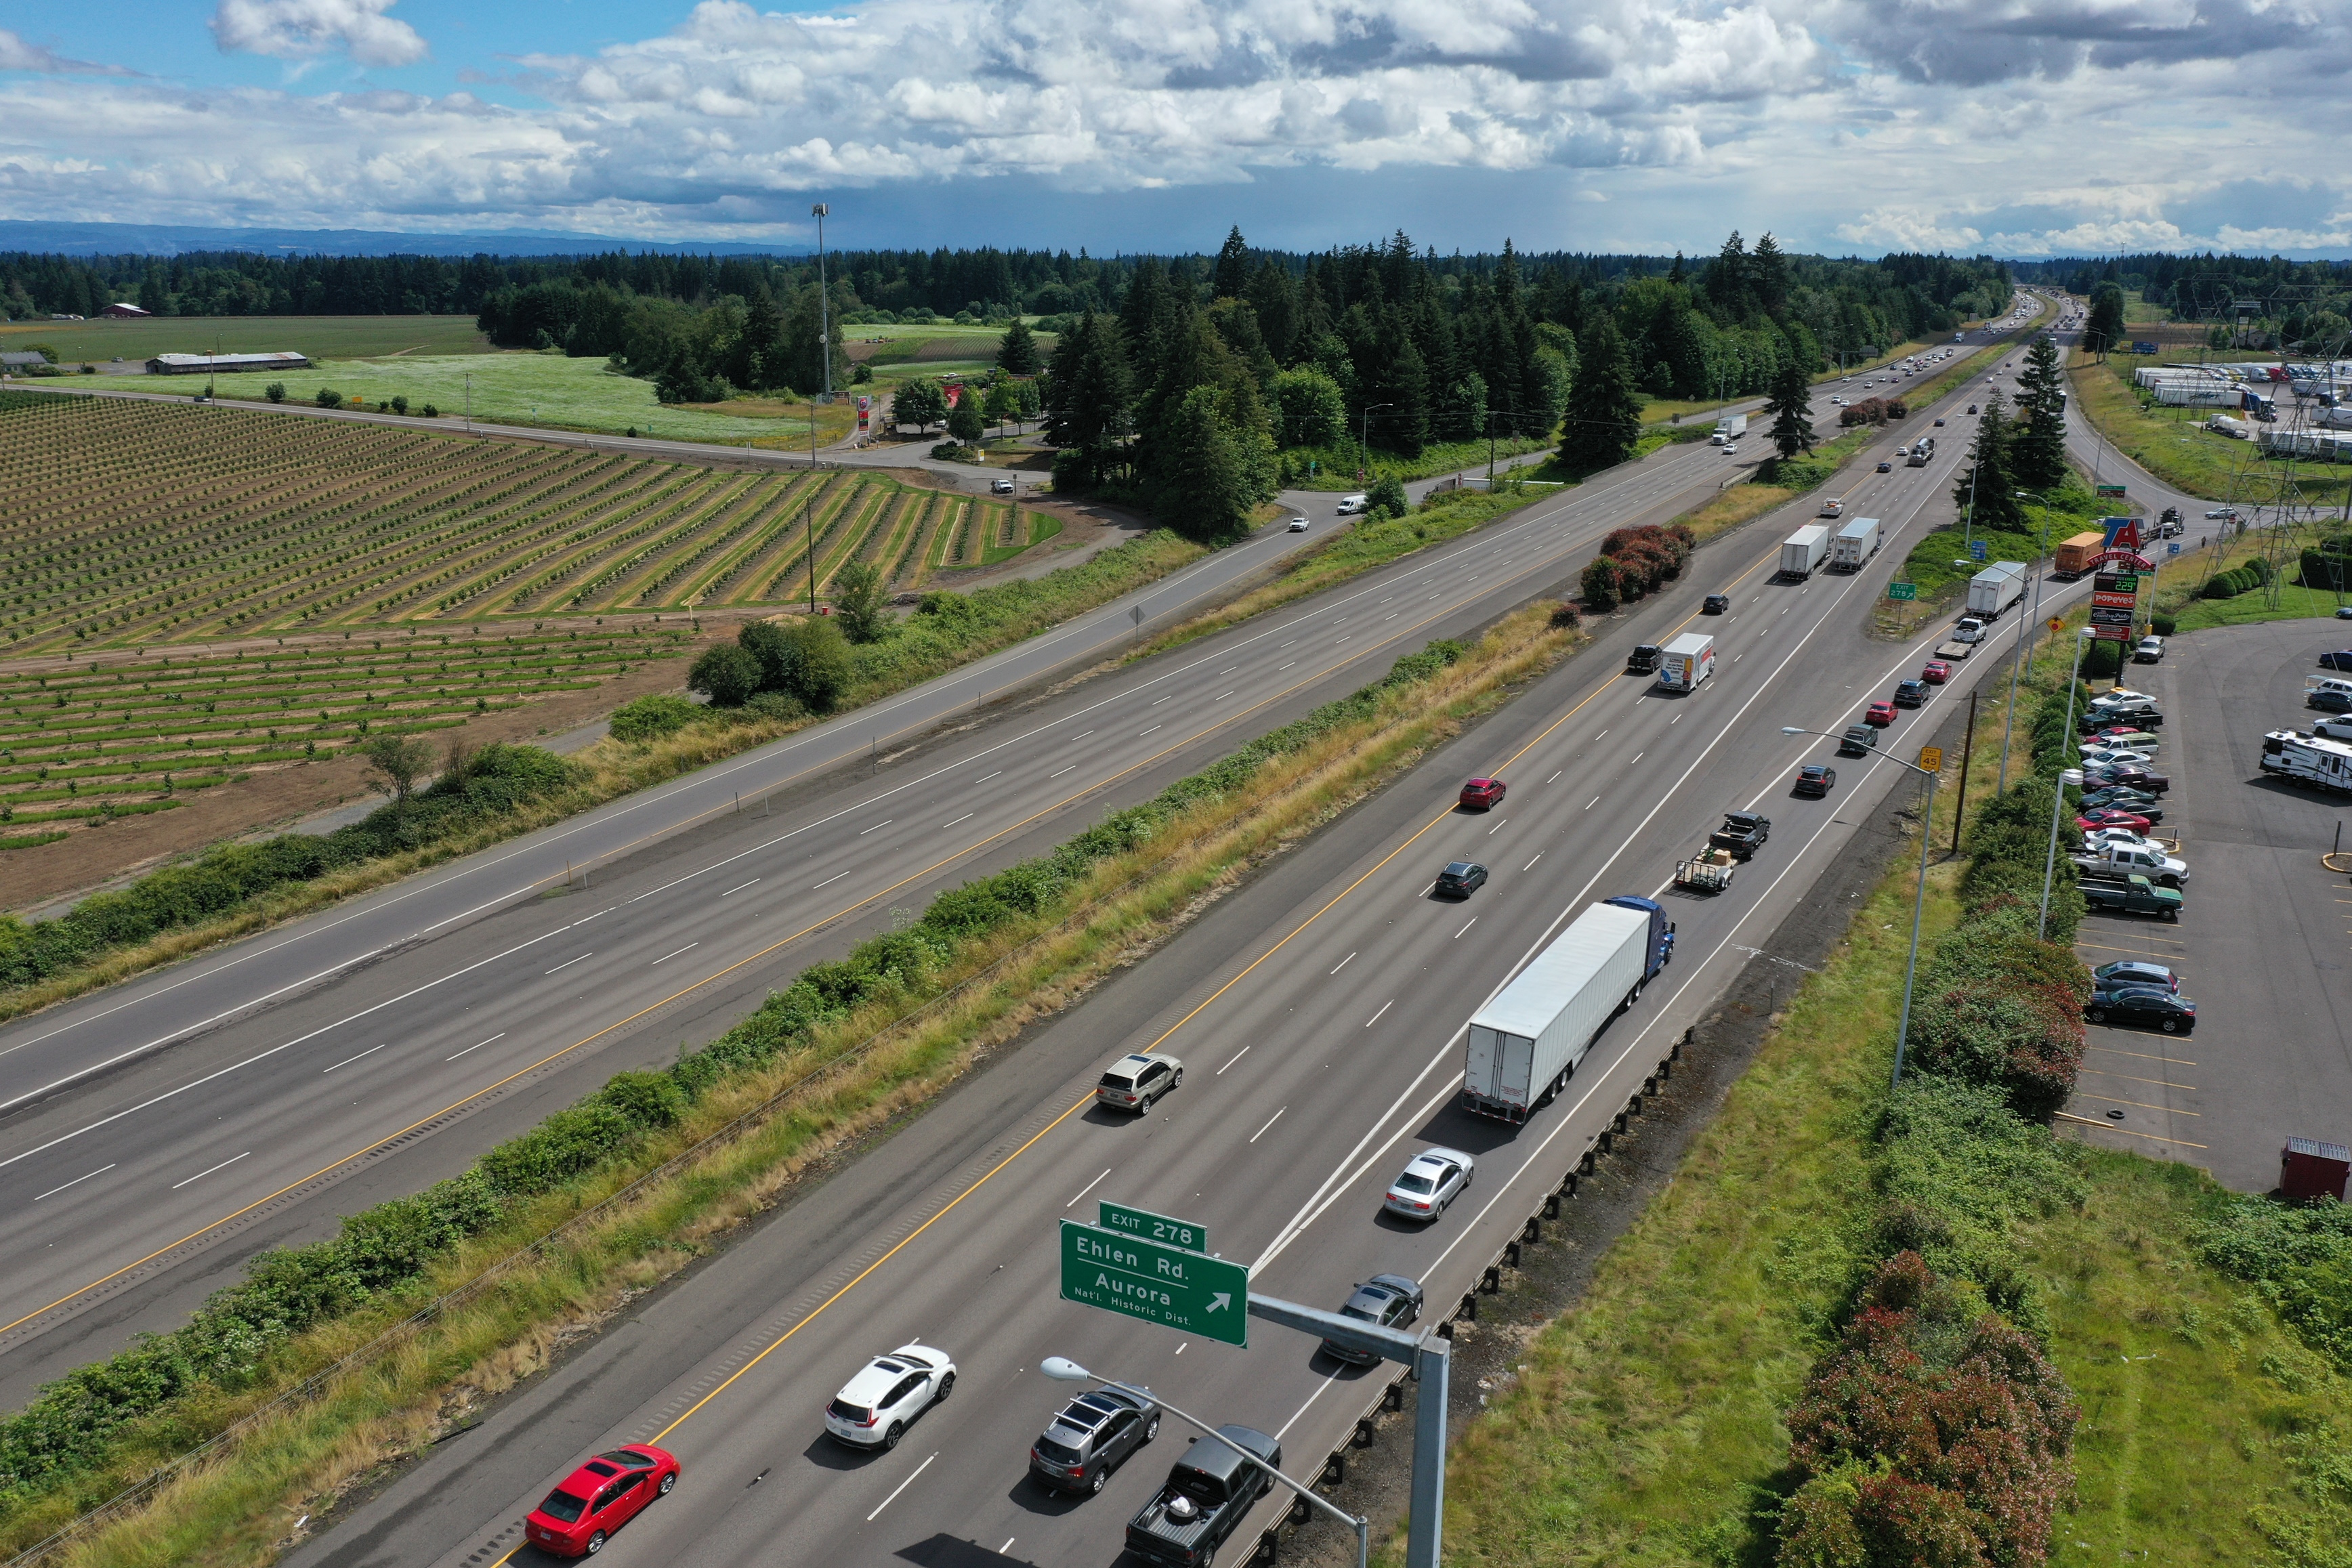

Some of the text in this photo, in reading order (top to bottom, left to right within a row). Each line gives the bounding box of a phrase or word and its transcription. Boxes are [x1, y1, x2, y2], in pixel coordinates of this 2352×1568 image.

[2101, 518, 2140, 549] TA
[2090, 554, 2147, 568] TRAVEL CENTER
[1923, 757, 1937, 765] 45
[1112, 1213, 1192, 1244] EXIT 278
[1076, 1236, 1189, 1280] Ehlen Rd.
[1095, 1273, 1171, 1306] Aurora
[1111, 1297, 1156, 1316] Historic
[1165, 1312, 1191, 1326] Dist.
